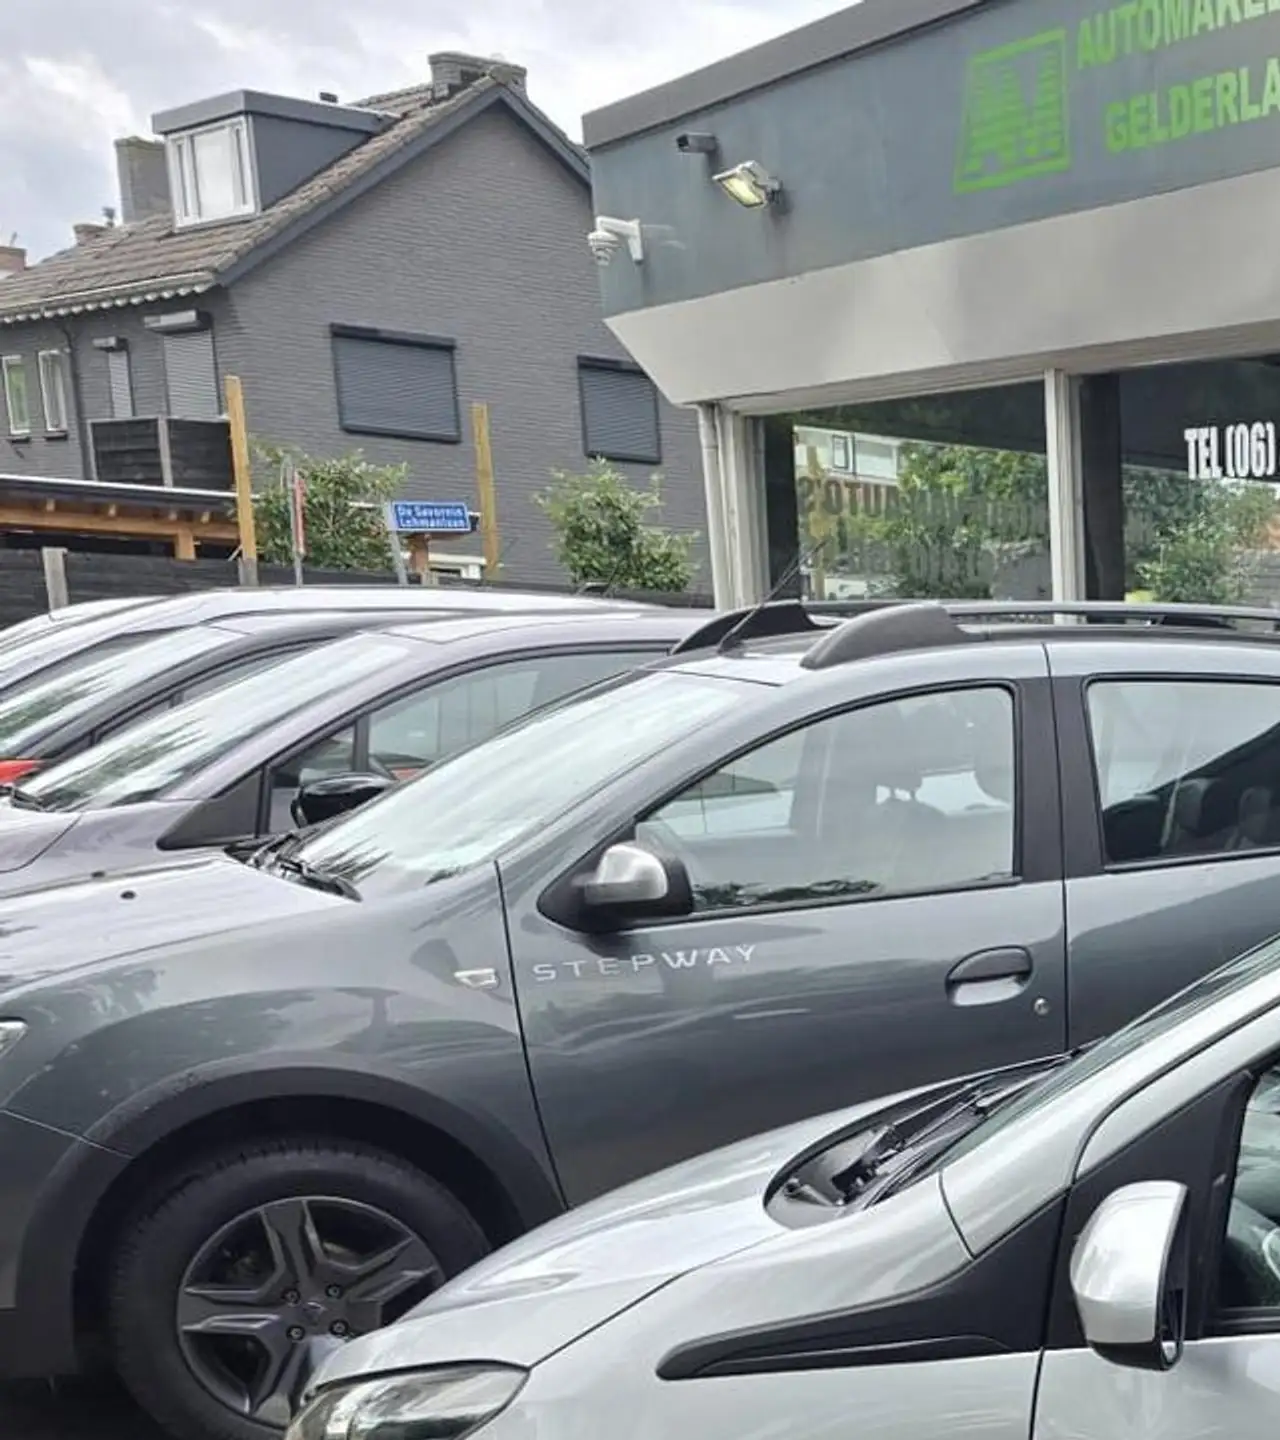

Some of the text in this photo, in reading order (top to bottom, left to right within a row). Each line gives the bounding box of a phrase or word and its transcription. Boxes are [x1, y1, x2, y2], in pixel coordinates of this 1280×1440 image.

[1184, 427, 1222, 480] TEL
[1225, 421, 1275, 478] (06)
[532, 944, 756, 982] STEPWAY
